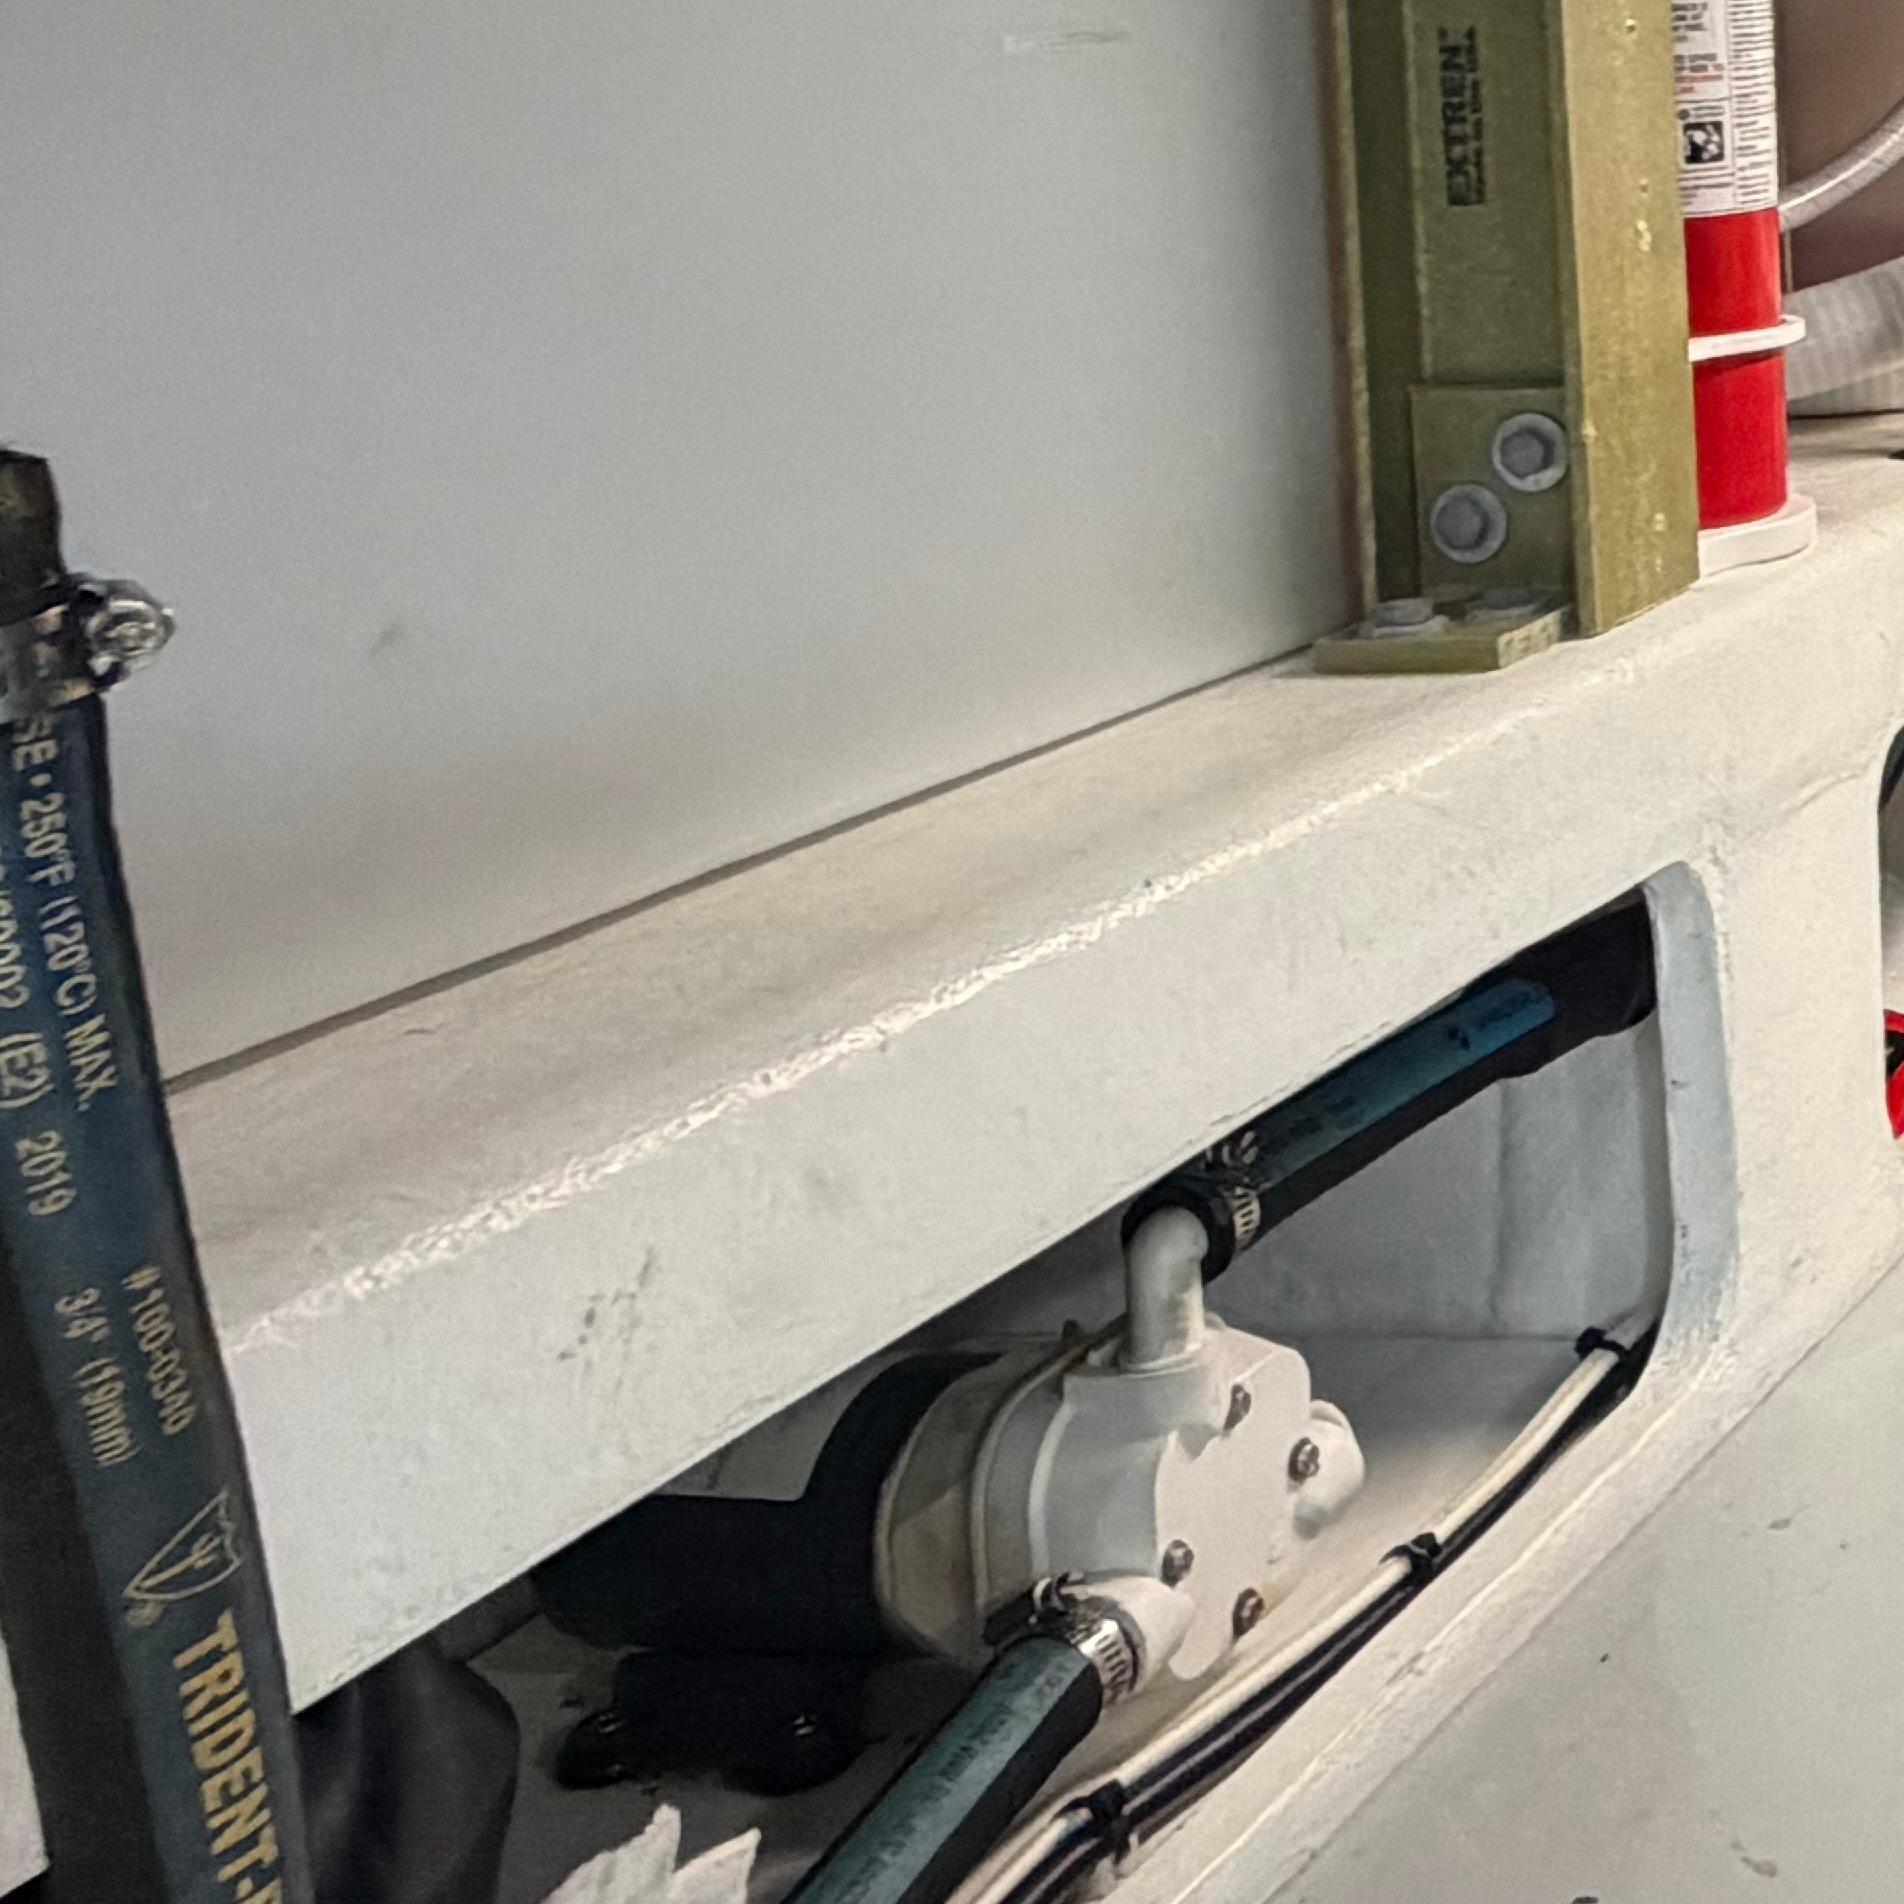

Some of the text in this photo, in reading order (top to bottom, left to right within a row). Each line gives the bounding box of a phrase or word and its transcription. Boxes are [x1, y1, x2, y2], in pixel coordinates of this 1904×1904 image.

[61, 1014, 118, 1113] MAX.
[15, 1130, 78, 1216] 2019
[71, 1355, 145, 1468] (19mm)
